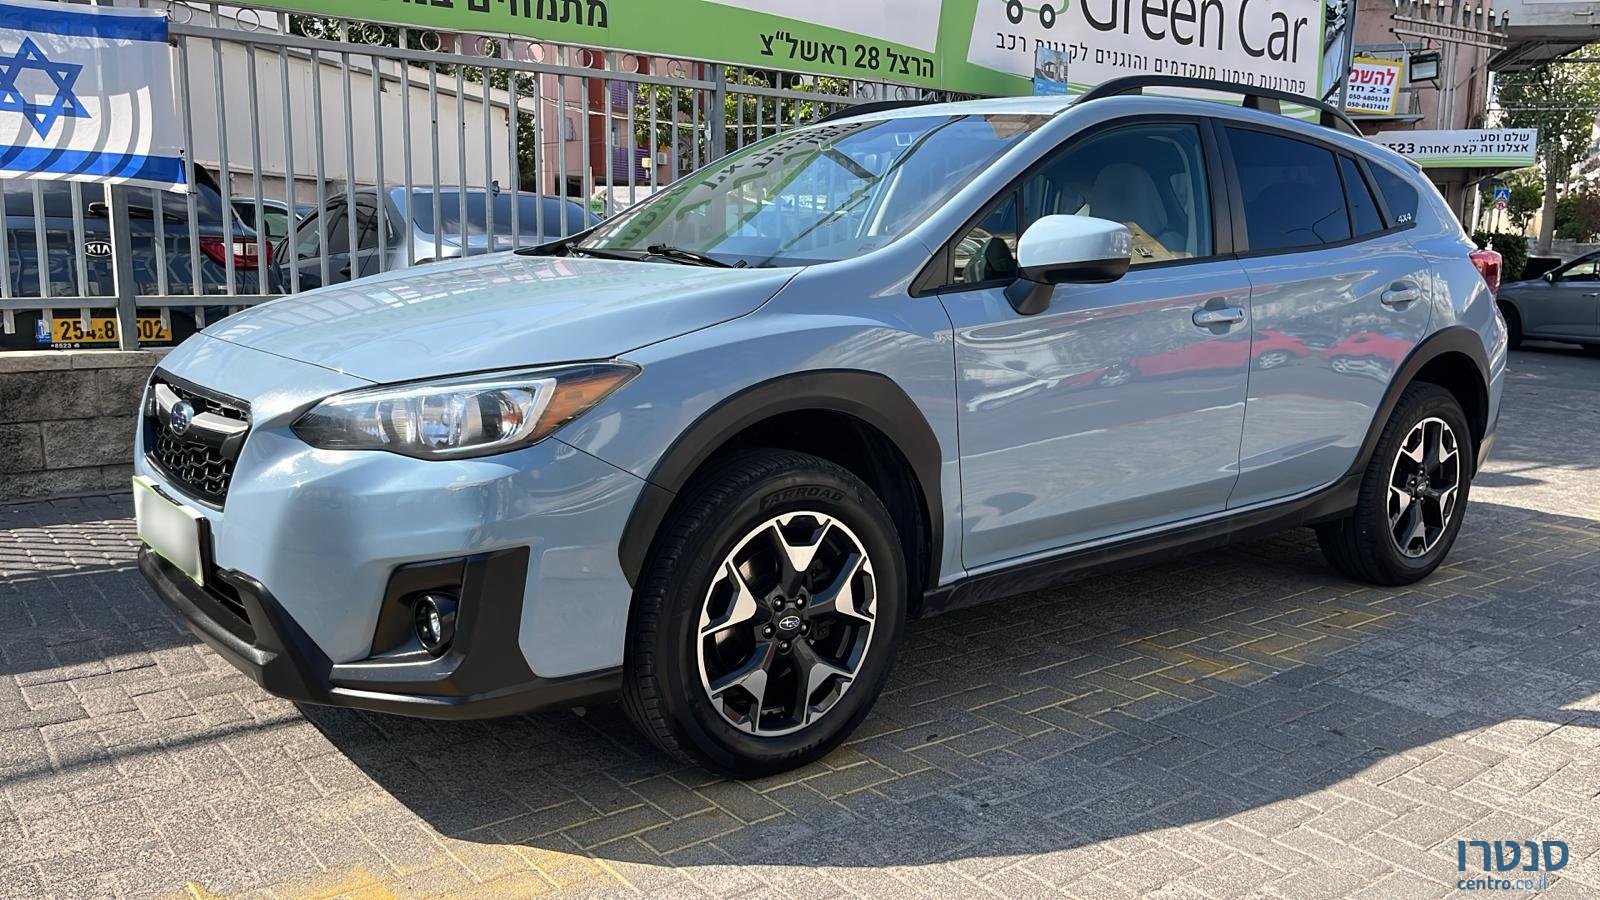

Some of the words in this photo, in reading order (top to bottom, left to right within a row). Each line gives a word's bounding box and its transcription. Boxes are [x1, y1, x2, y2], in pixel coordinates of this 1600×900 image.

[1238, 0, 1308, 63] Car
[996, 32, 1026, 52] רכב
[854, 44, 879, 70] 28
[886, 48, 934, 78] הרצל
[1096, 49, 1147, 70] והוגנים
[1155, 58, 1217, 80] מתקדמים
[1222, 68, 1254, 87] מימון
[1260, 74, 1306, 93] פתרונות
[1504, 132, 1529, 142] שלם
[1381, 143, 1415, 154] 523
[1418, 145, 1449, 154] אחרת
[1452, 144, 1477, 155] קצת
[1480, 144, 1493, 153] זה
[1497, 143, 1528, 153] אצלנו
[87, 244, 111, 254] KIA
